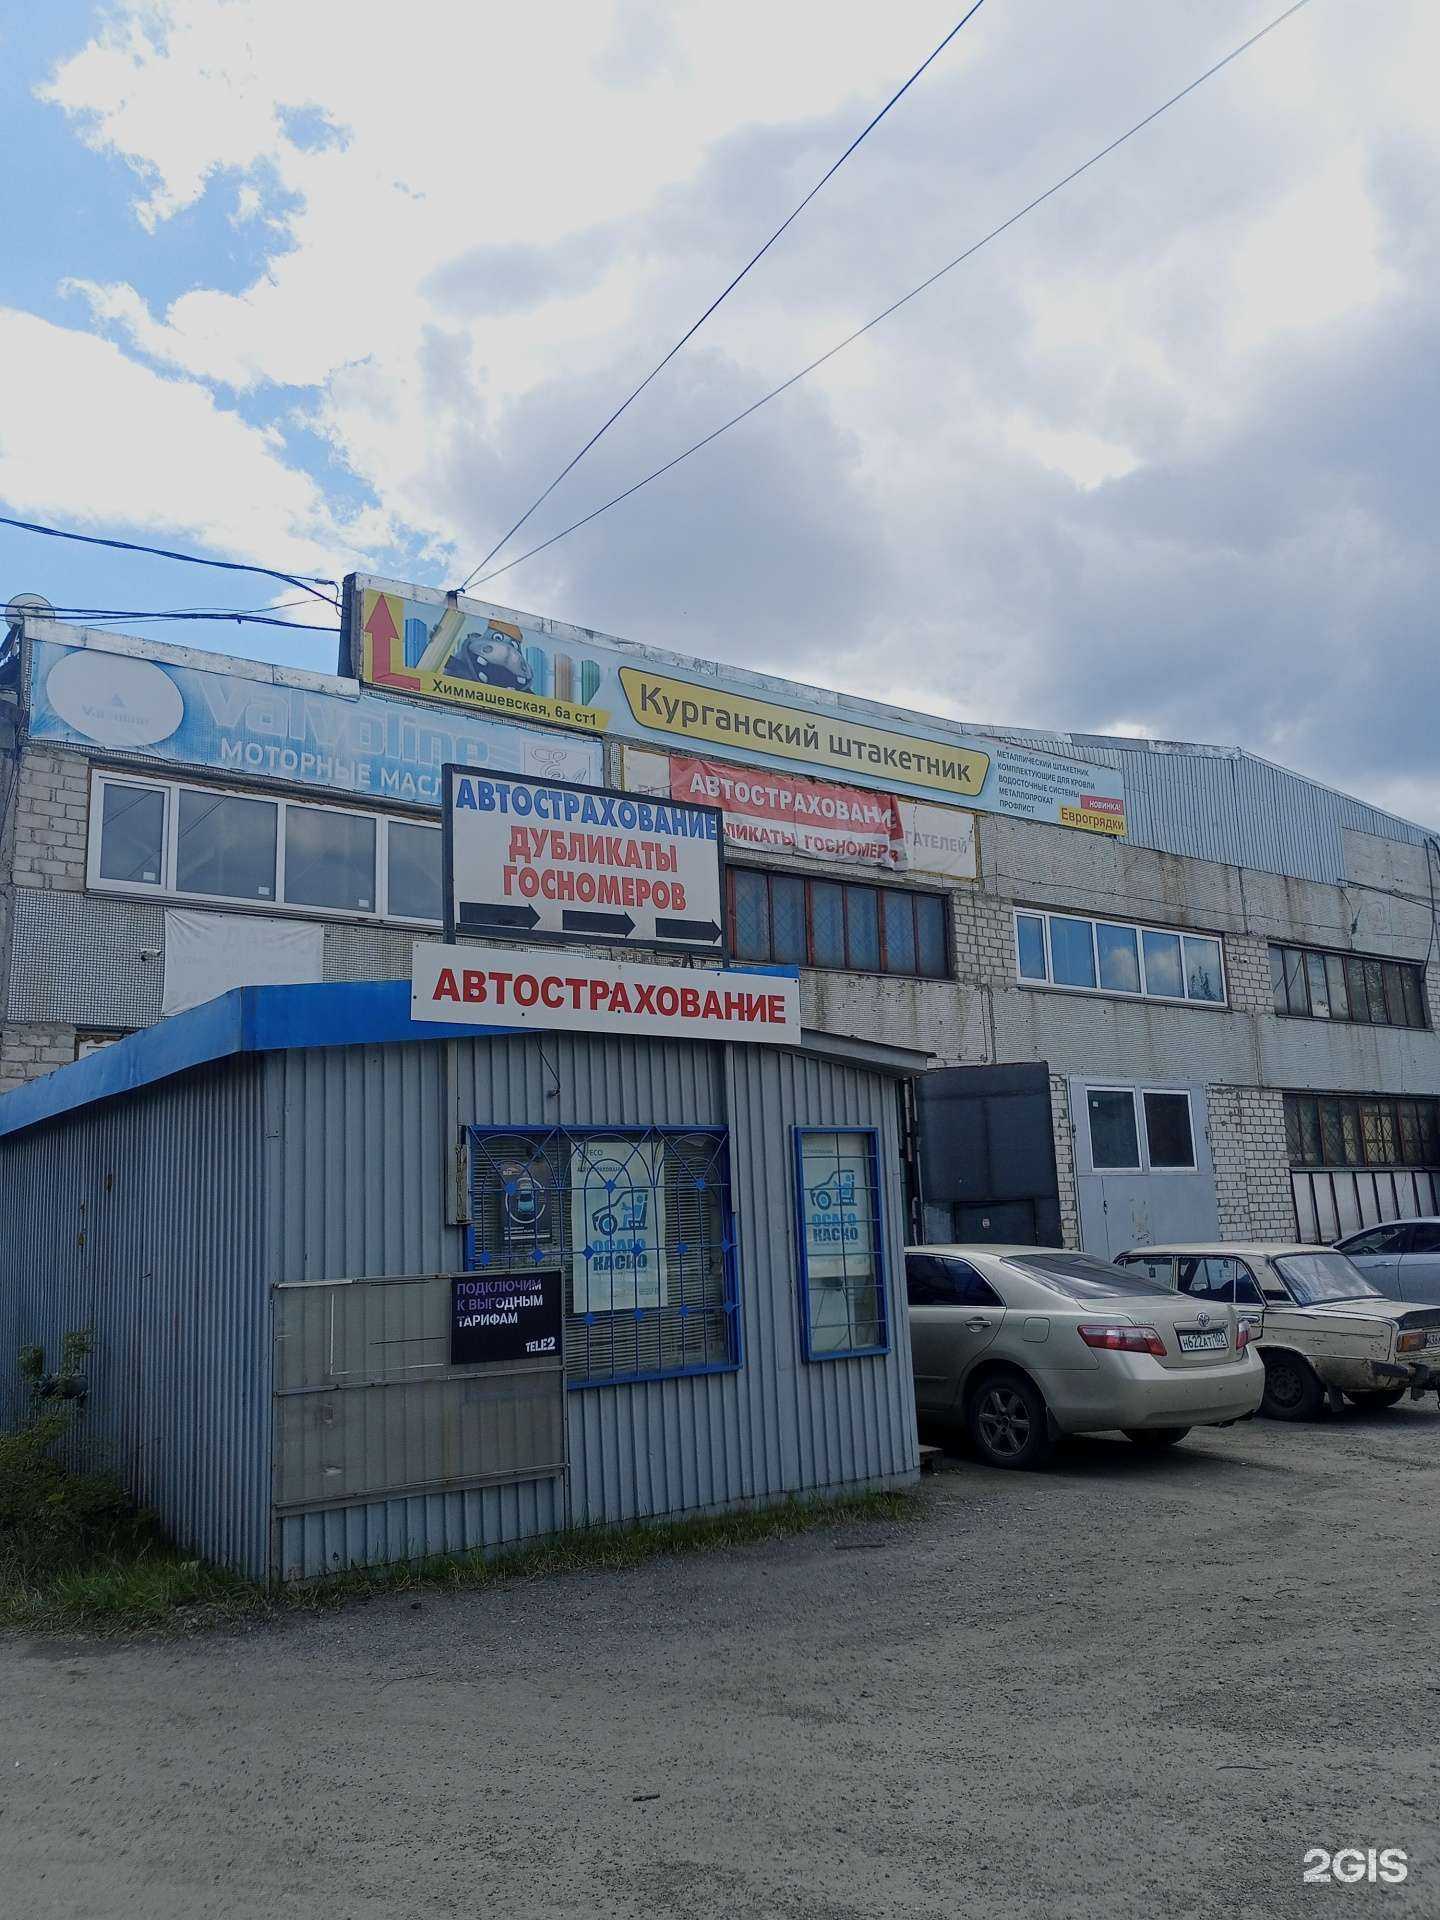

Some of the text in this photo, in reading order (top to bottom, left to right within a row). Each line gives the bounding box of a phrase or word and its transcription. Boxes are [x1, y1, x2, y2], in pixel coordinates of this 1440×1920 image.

[432, 678, 597, 727] Химмашевская, 6а ст1
[641, 683, 972, 783] Курганский штакетник
[221, 737, 372, 785] МОТОРНЫЕ
[997, 750, 1089, 777] МЕТАЛЛИЧЕСКИЙ ШТАКЕТНИК
[997, 763, 1095, 790] КОМПЛЕКТУЮЩИЕ ДЛЯ КРОВЛИ
[998, 775, 1080, 798] ВОДОСТОЧНЫЕ СИСТЕМЫ
[999, 787, 1054, 804] МЕТАЛЛОПРОКАТ
[1000, 799, 1035, 813] ПРОФЛИСТ
[1089, 801, 1121, 811] НОВИНКА!
[456, 779, 717, 840] АВТОСТРАХОВАНИЕ
[1061, 807, 1124, 830] Еврогрядки
[509, 826, 678, 872] ДУБЛИКАТЫ
[504, 865, 686, 910] ГОСНОМЕРОВ
[433, 968, 786, 1023] АВТОСТРАХОВАНИЕ
[457, 1279, 541, 1295] ПОДКЛЮЧИМ
[458, 1295, 543, 1311] К ВЫГОДНЫМ
[457, 1312, 518, 1327] ТАРИФАМ
[525, 1337, 556, 1352] TELE2
